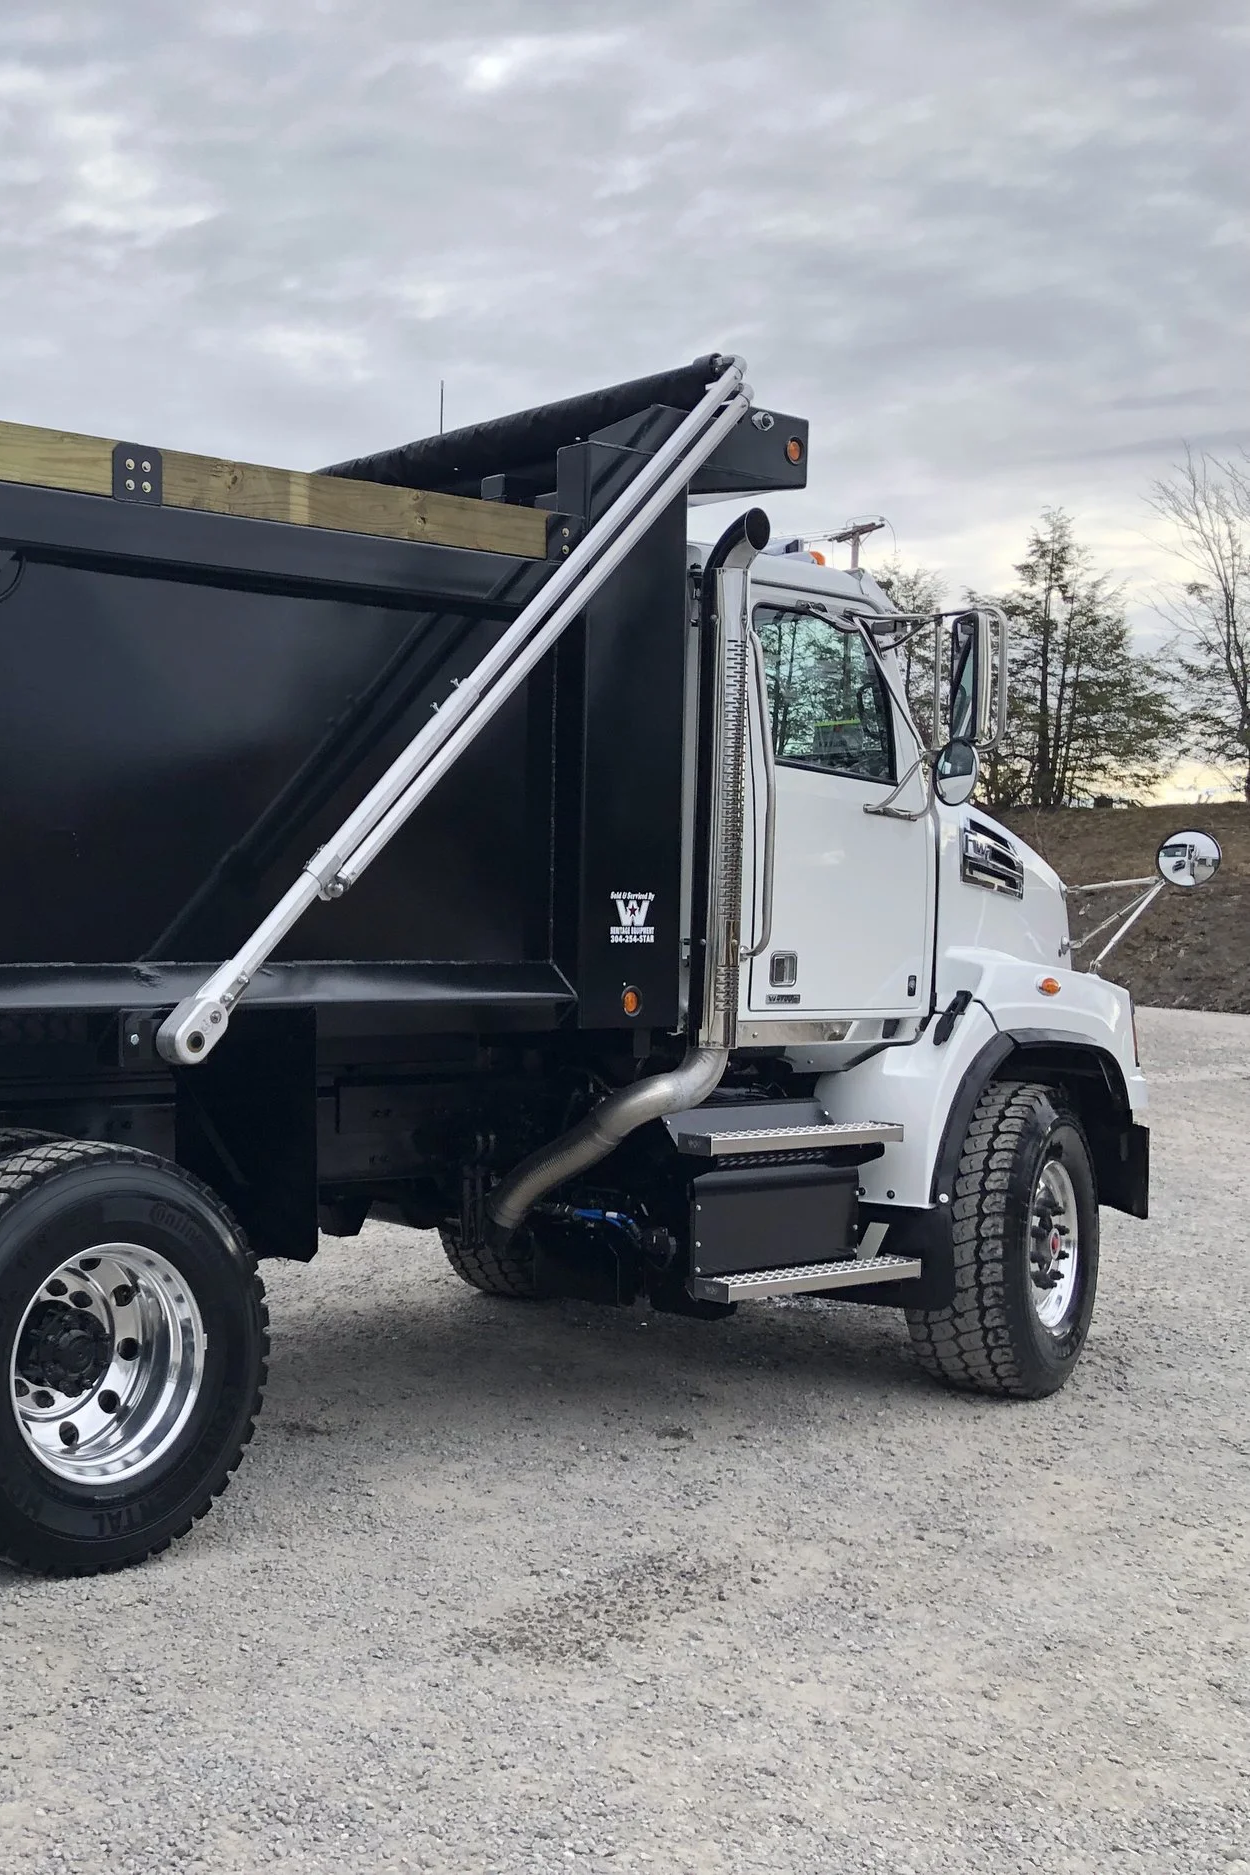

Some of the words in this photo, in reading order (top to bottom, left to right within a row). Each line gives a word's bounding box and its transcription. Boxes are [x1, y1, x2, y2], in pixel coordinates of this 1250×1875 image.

[610, 891, 622, 900] Sold
[648, 892, 655, 901] By
[610, 935, 655, 943] 304-254-STAR
